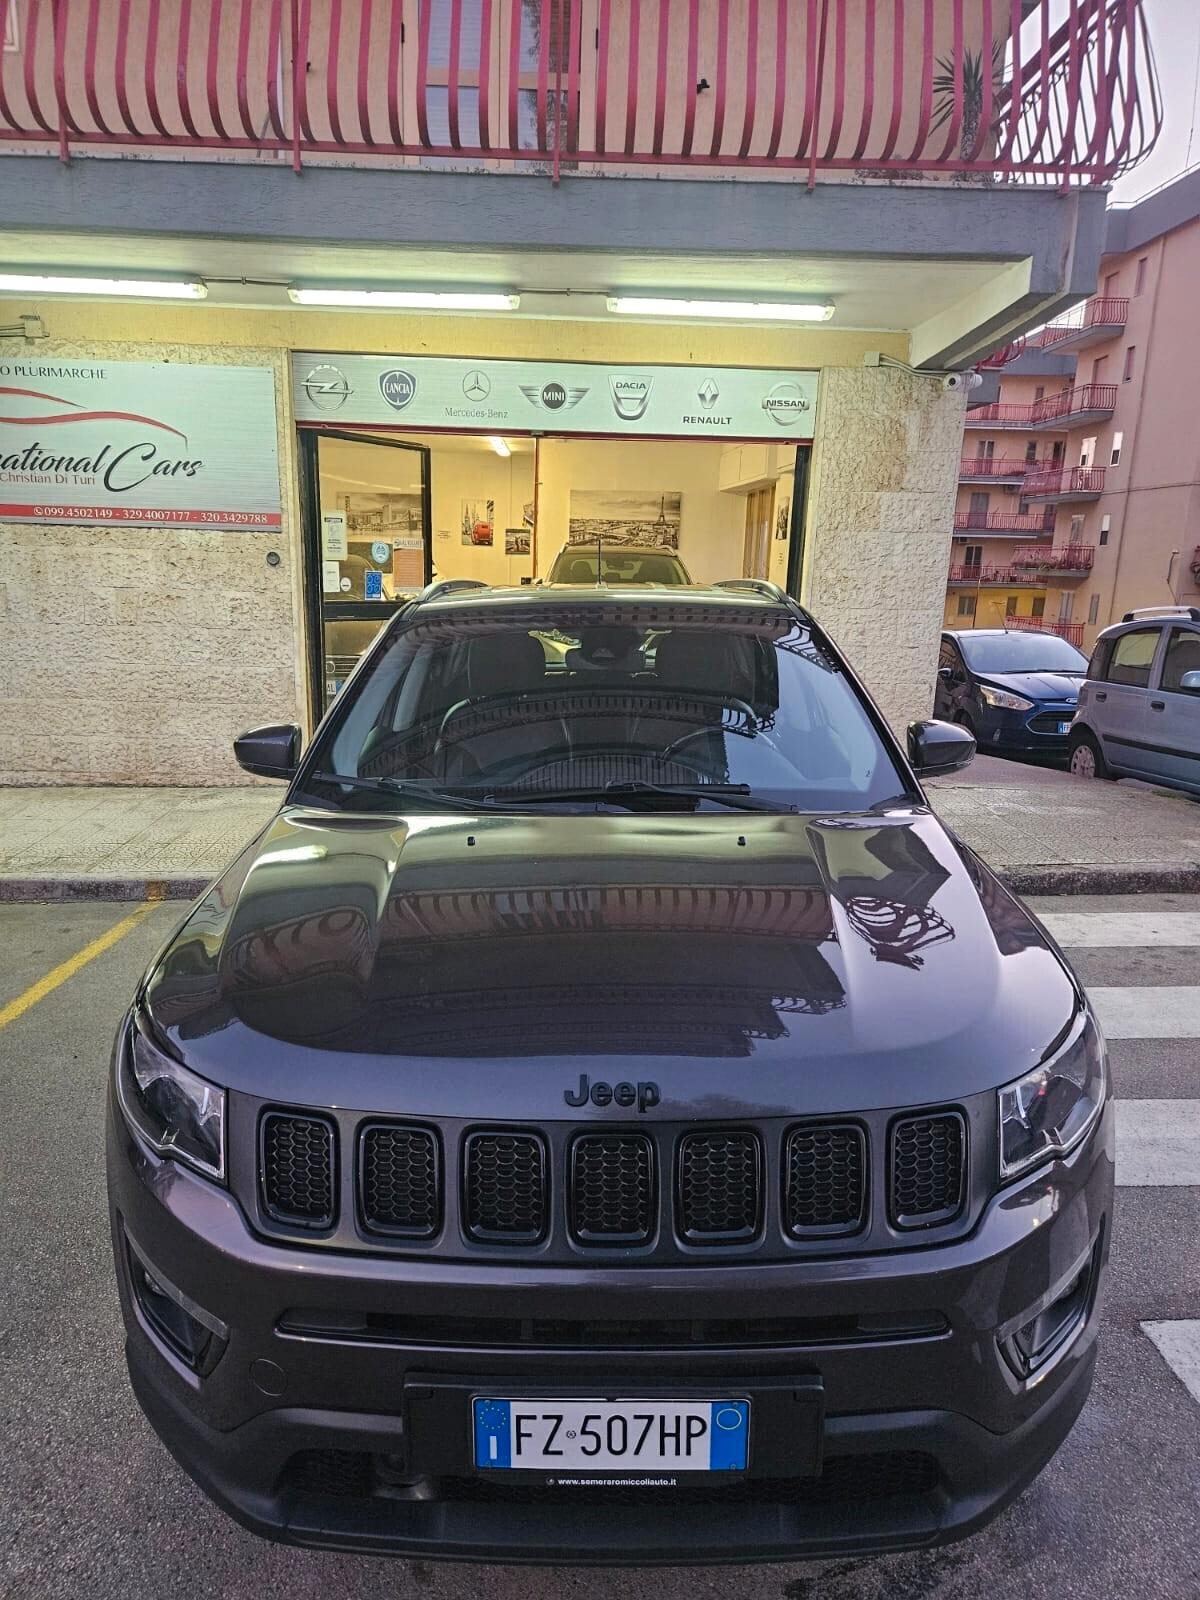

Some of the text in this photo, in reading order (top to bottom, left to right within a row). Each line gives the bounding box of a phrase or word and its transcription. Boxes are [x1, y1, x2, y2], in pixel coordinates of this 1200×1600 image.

[14, 366, 108, 379] PLURIMARCHE
[385, 383, 410, 394] LANCIA
[615, 382, 646, 390] DACIA
[543, 391, 565, 401] MINI
[766, 399, 805, 408] NISSAN
[444, 407, 509, 419] Mercedes-Benz
[682, 415, 733, 426] RENAULT
[0, 442, 205, 493] ational Cars
[0, 472, 96, 486] Christian Di Turi
[44, 506, 113, 519] 099.4502149
[122, 509, 190, 521] 329.4007177
[200, 512, 268, 524] 320.3429788
[563, 1073, 661, 1114] Jeep
